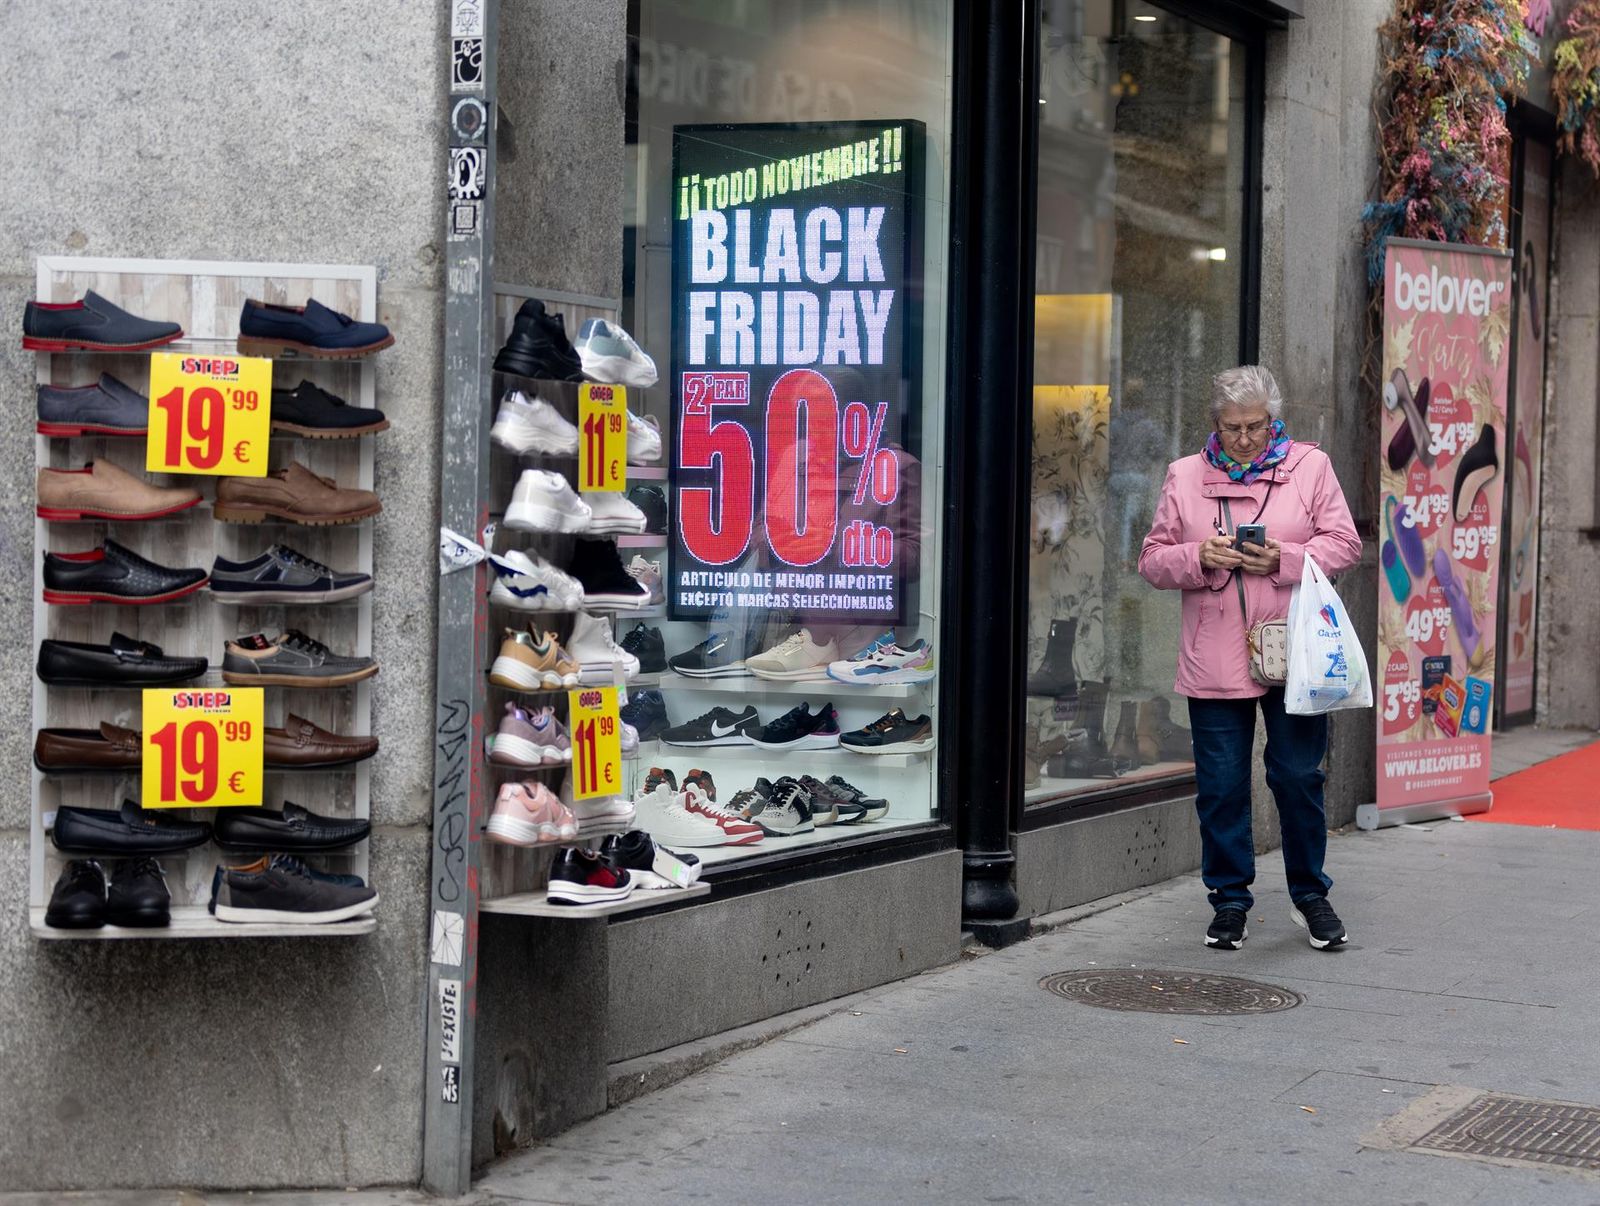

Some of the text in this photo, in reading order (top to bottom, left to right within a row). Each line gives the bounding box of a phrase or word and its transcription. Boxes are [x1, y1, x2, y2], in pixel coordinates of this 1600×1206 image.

[762, 127, 902, 199] NOVIEMBRE!!
[692, 206, 885, 284] BLACK
[1395, 262, 1496, 316] belover
[690, 290, 895, 365] FRIDAY
[182, 358, 238, 374] STEP
[714, 379, 747, 399] PAR
[233, 441, 251, 463] €
[611, 460, 619, 480] €
[1436, 514, 1443, 527] €
[842, 520, 893, 568] dto
[1484, 546, 1490, 558] €
[681, 572, 893, 590] ARTICULO DE MENOR IMPORTE
[681, 592, 893, 610] EXCEPTO MARCAS SELECCIONADAS
[1440, 627, 1447, 640] €
[174, 692, 230, 709] STEP
[1408, 703, 1415, 719] €
[605, 763, 612, 783] €
[1385, 752, 1481, 778] WWW.BELOVER.ES
[228, 771, 245, 793] €
[443, 1084, 457, 1102] NS
